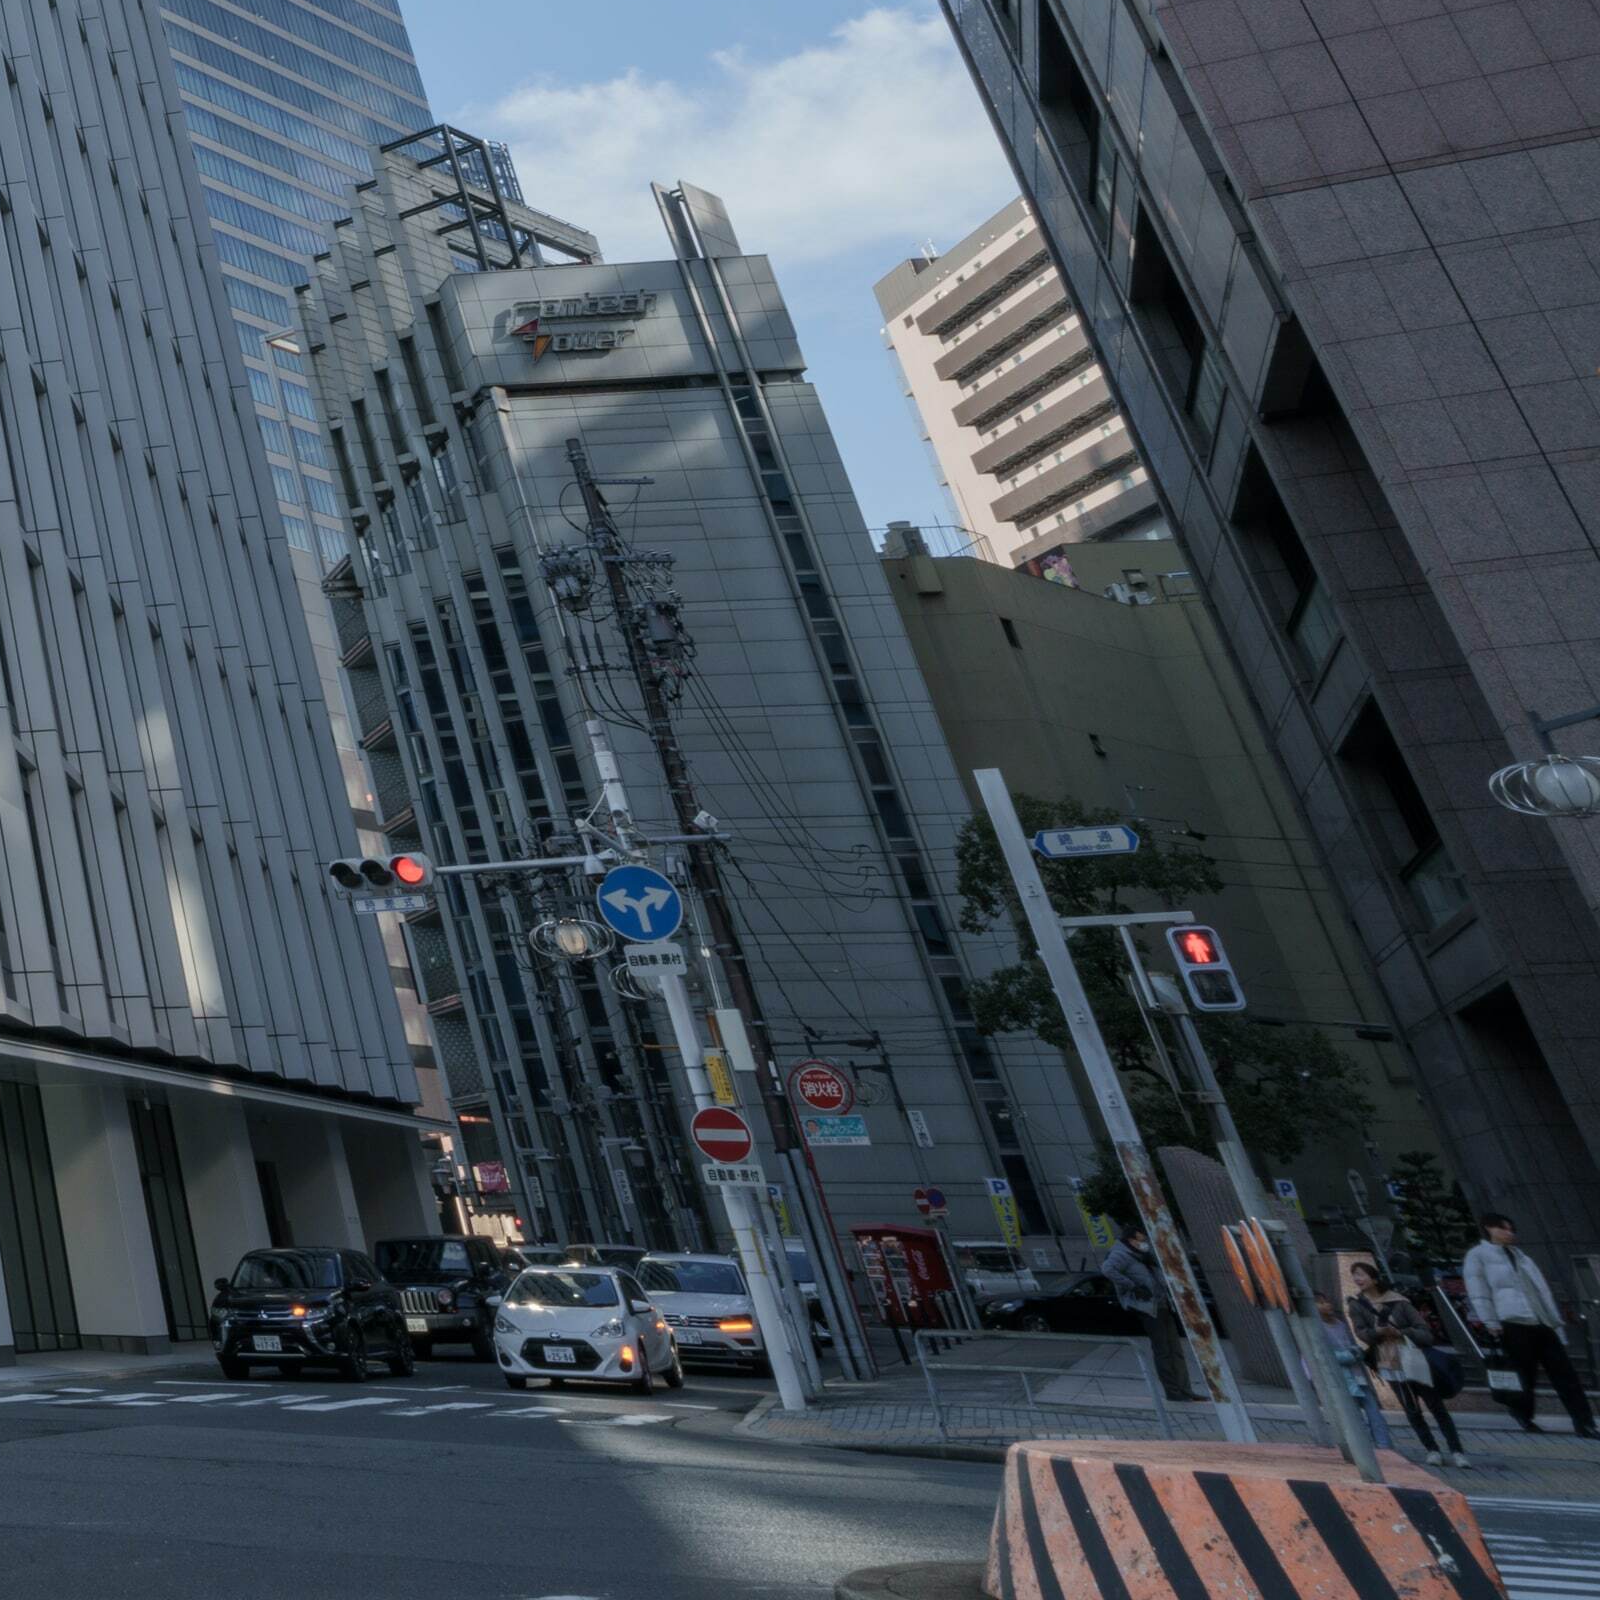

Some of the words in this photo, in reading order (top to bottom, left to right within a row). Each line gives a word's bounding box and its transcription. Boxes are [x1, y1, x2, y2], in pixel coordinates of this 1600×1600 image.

[801, 1081, 842, 1097] 消火栓
[992, 1181, 1006, 1194] P
